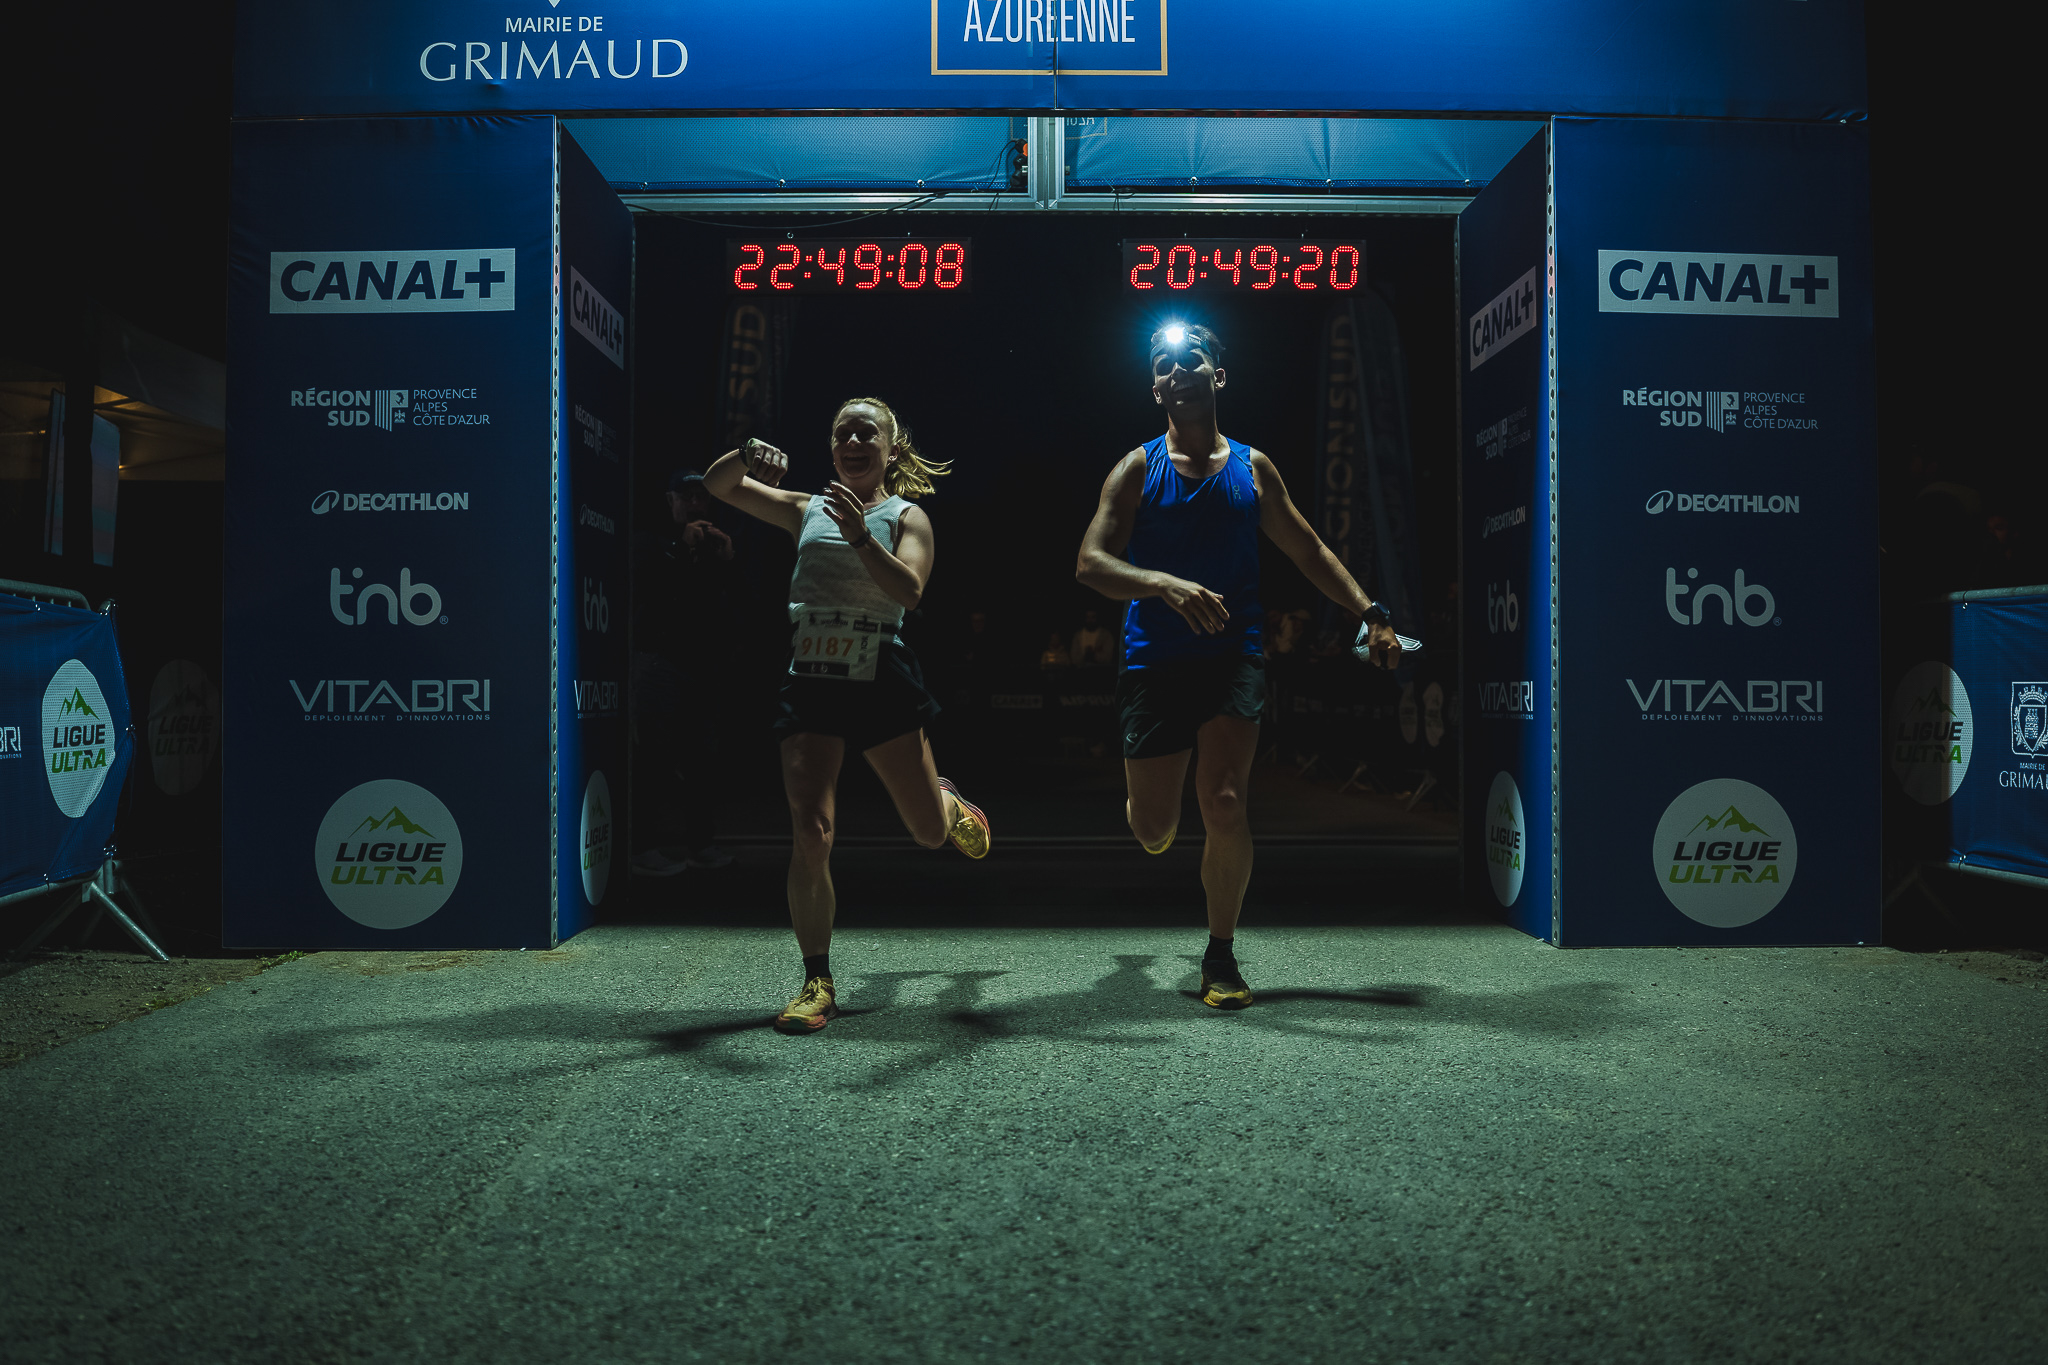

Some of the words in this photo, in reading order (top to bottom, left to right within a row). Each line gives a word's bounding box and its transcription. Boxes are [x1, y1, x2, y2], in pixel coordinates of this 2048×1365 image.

[505, 16, 572, 33] MAIRIE
[578, 16, 603, 32] DE
[419, 39, 688, 82] GRIMAUD
[733, 242, 965, 290] 22:49:08
[1129, 244, 1360, 290] 20:49:20
[280, 258, 505, 302] CANAL+
[1609, 259, 1829, 305] CANAL+
[572, 279, 622, 355] CANAL+
[1472, 280, 1534, 357] CANAL+
[290, 387, 371, 407] RÉGION
[413, 388, 478, 400] PROVENCE
[1622, 387, 1702, 407] RÉGION
[1743, 391, 1806, 404] PROVENCE
[412, 402, 448, 413] ALPES
[1743, 405, 1778, 416] ALPES
[327, 410, 371, 427] SUD
[412, 413, 445, 426] CÔTE
[448, 414, 490, 426] D'AZUR
[1660, 410, 1702, 427] SUD
[1743, 417, 1775, 429] CÔTE
[1777, 418, 1819, 430] D'AZUR
[343, 492, 469, 511] DECATHLON
[1677, 493, 1800, 514] DECATHLON
[586, 507, 615, 536] DECATHLON
[1490, 506, 1526, 534] DECATHLON
[802, 636, 855, 657] 9187
[289, 679, 491, 713] VITABRI
[573, 679, 619, 710] VITABRI
[1478, 680, 1534, 712] VITABRI
[1625, 679, 1824, 713] VITABRI
[304, 714, 386, 722] DEPLOIEMENT
[396, 714, 491, 722] D'INNOVATIONS
[1642, 714, 1722, 722] DEPLOIEMENT
[1733, 714, 1824, 722] D'INNOVATIONS
[53, 724, 106, 748] LIGUE
[1897, 721, 1964, 742] LIGUE
[51, 748, 107, 774] ULTRA
[1895, 744, 1962, 764] ULTRA
[2019, 762, 2038, 770] MAIRIE
[2038, 763, 2046, 771] DE
[1999, 770, 2048, 790] GRIMA
[584, 823, 609, 850] LIGUE
[1490, 825, 1521, 850] LIGUE
[335, 842, 447, 863] LIGUE
[1489, 845, 1521, 871] ULTRA
[1673, 841, 1782, 861] LIGUE
[330, 866, 445, 886] ULTRA
[1668, 864, 1780, 884] ULTRA
